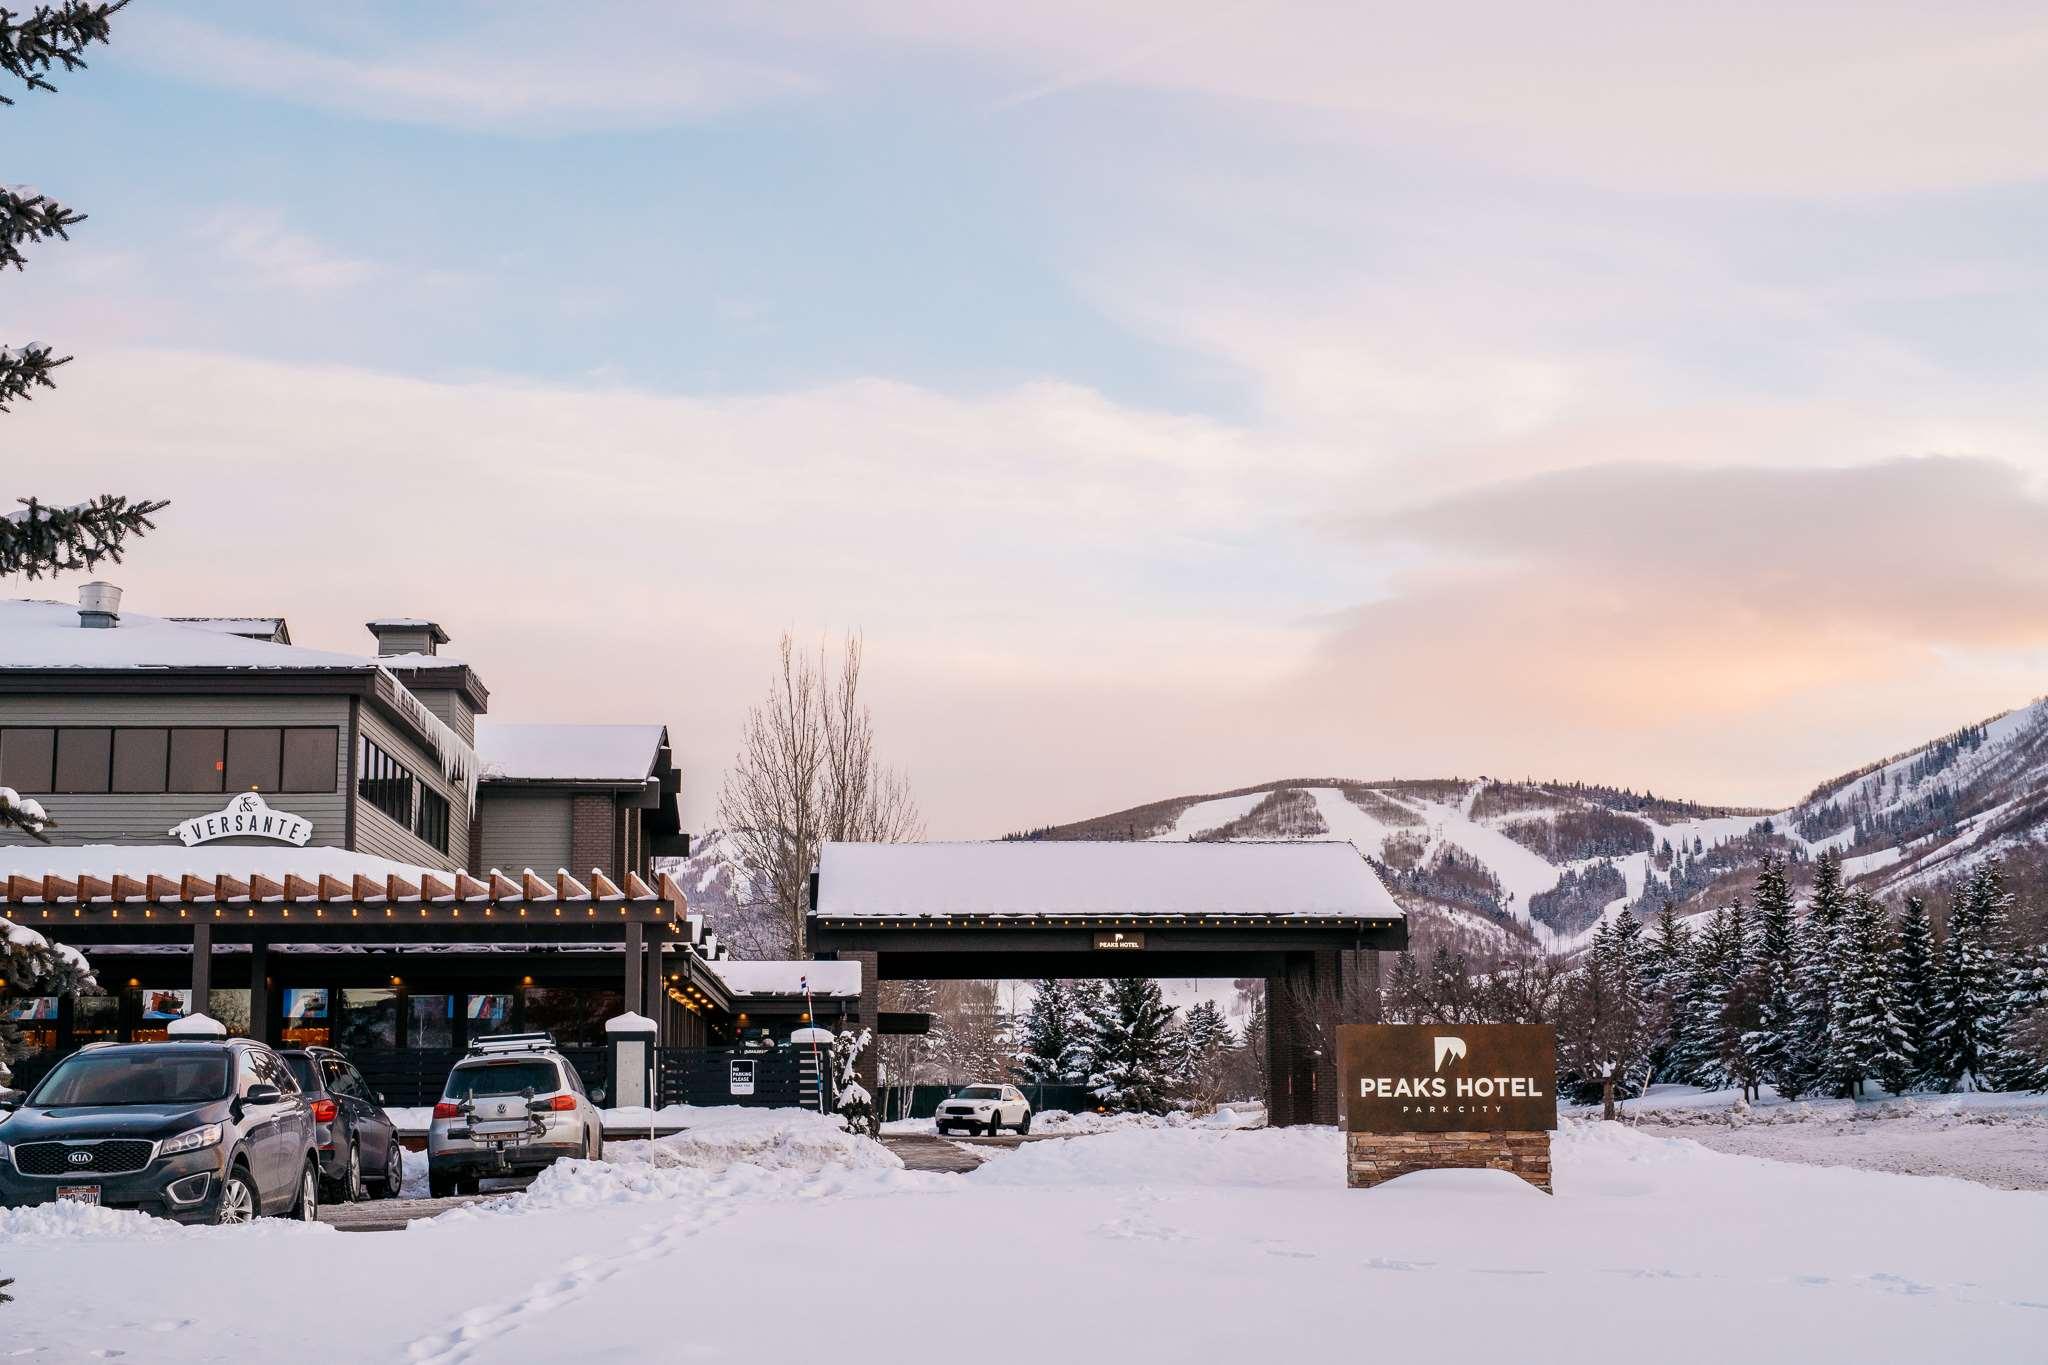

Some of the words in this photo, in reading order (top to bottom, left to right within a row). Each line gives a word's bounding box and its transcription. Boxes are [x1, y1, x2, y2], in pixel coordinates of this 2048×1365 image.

[191, 814, 301, 840] VERSANTE
[1360, 1077, 1447, 1098] PEAKS
[1456, 1077, 1543, 1097] HOTEL
[1403, 1105, 1449, 1113] PARK
[1458, 1105, 1502, 1113] CITY
[71, 1154, 89, 1162] KIA
